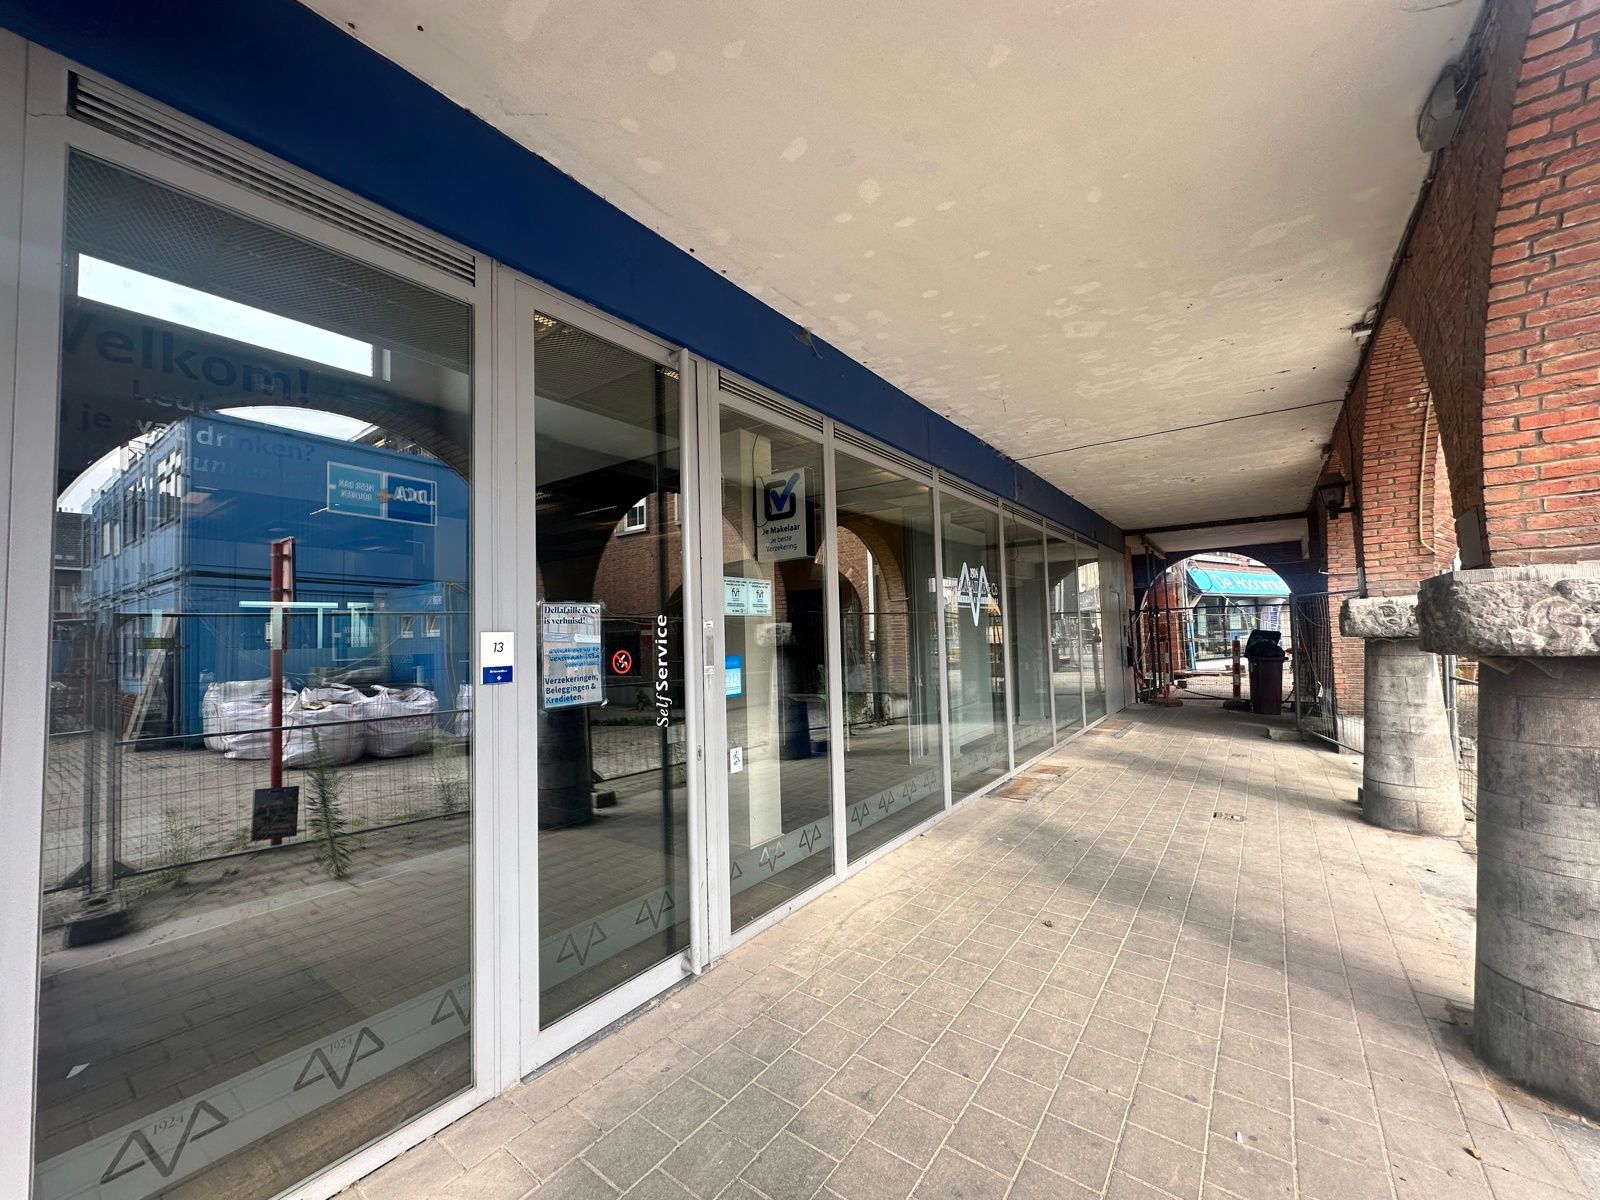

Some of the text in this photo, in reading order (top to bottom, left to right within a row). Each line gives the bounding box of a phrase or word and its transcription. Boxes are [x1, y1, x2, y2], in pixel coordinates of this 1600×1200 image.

[196, 424, 315, 463] drinken?
[770, 524, 801, 534] Makelaar
[493, 641, 504, 653] 13
[544, 674, 599, 686] Verzekeringen,
[545, 684, 590, 695] Beleggingen
[545, 694, 585, 705] Kredieten.
